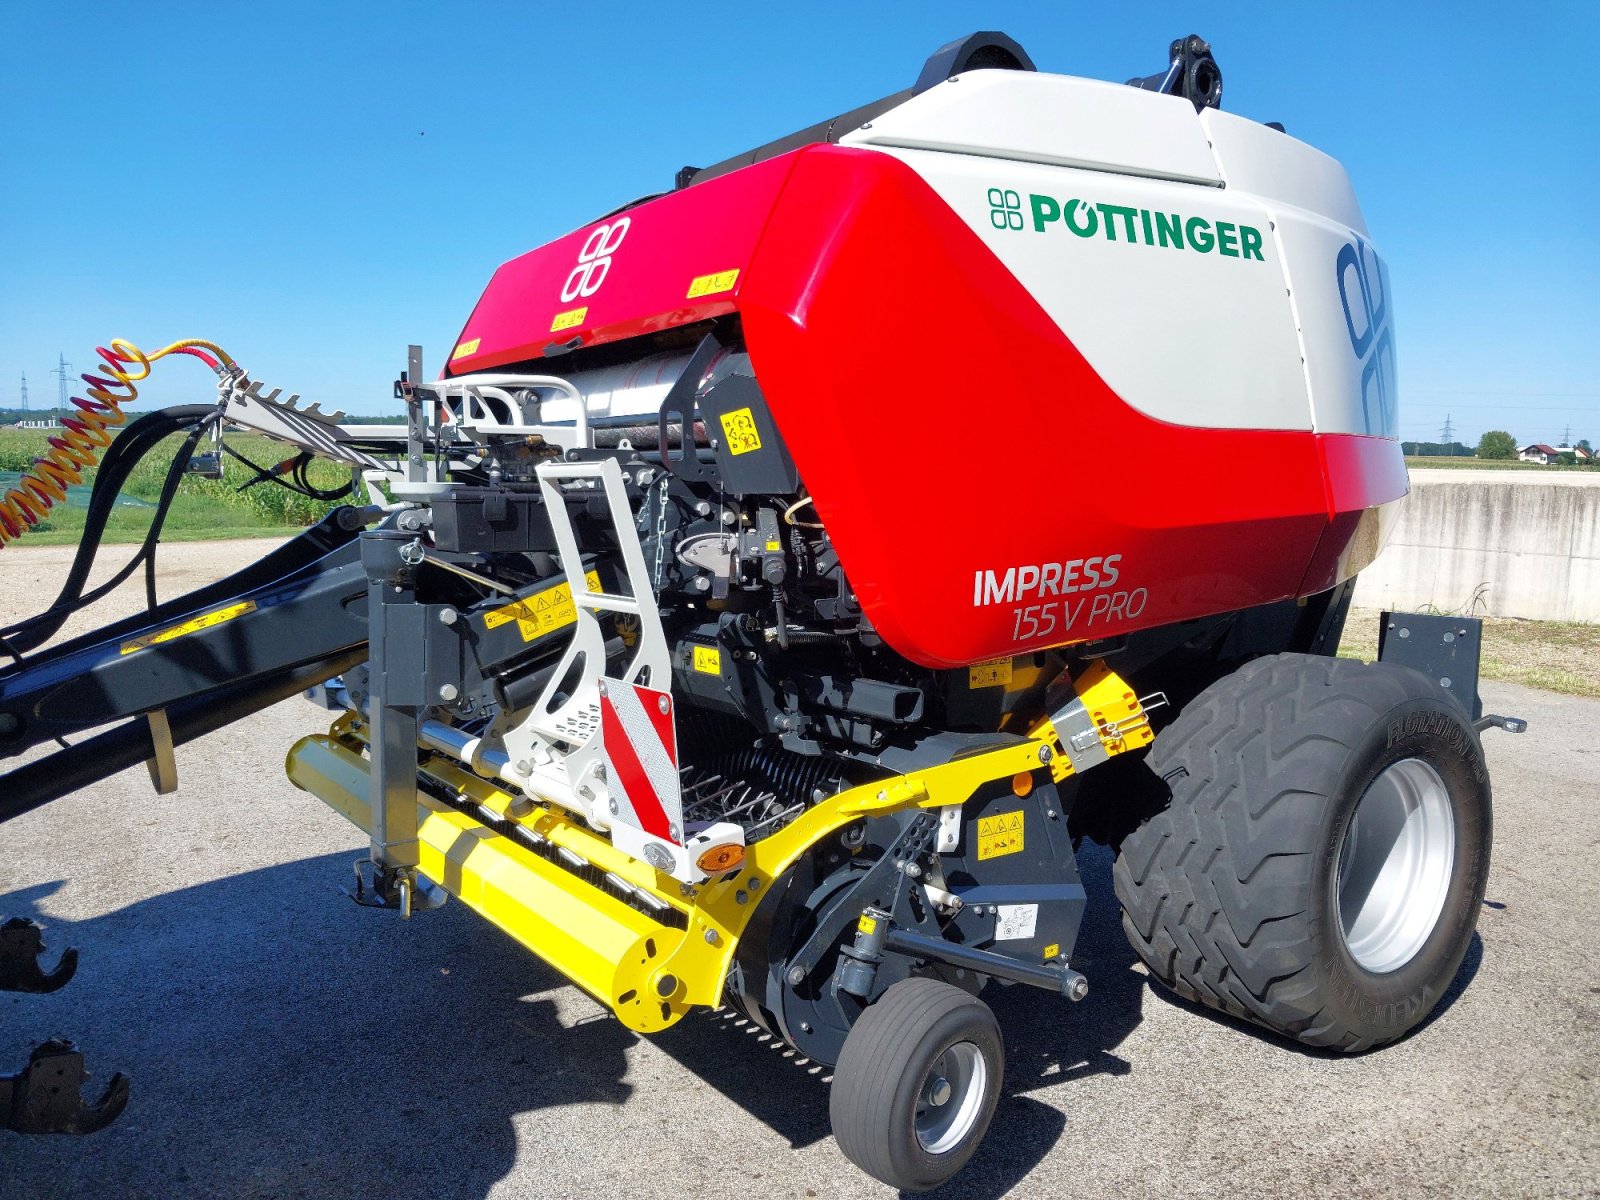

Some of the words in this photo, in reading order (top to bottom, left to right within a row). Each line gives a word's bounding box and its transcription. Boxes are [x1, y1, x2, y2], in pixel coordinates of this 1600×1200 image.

[1029, 193, 1265, 261] PÖTTINGER
[973, 554, 1122, 607] IMPRESS
[1012, 602, 1060, 641] 155
[1064, 597, 1086, 631] V
[1087, 587, 1149, 627] PRO
[1387, 710, 1472, 756] FLOTATION
